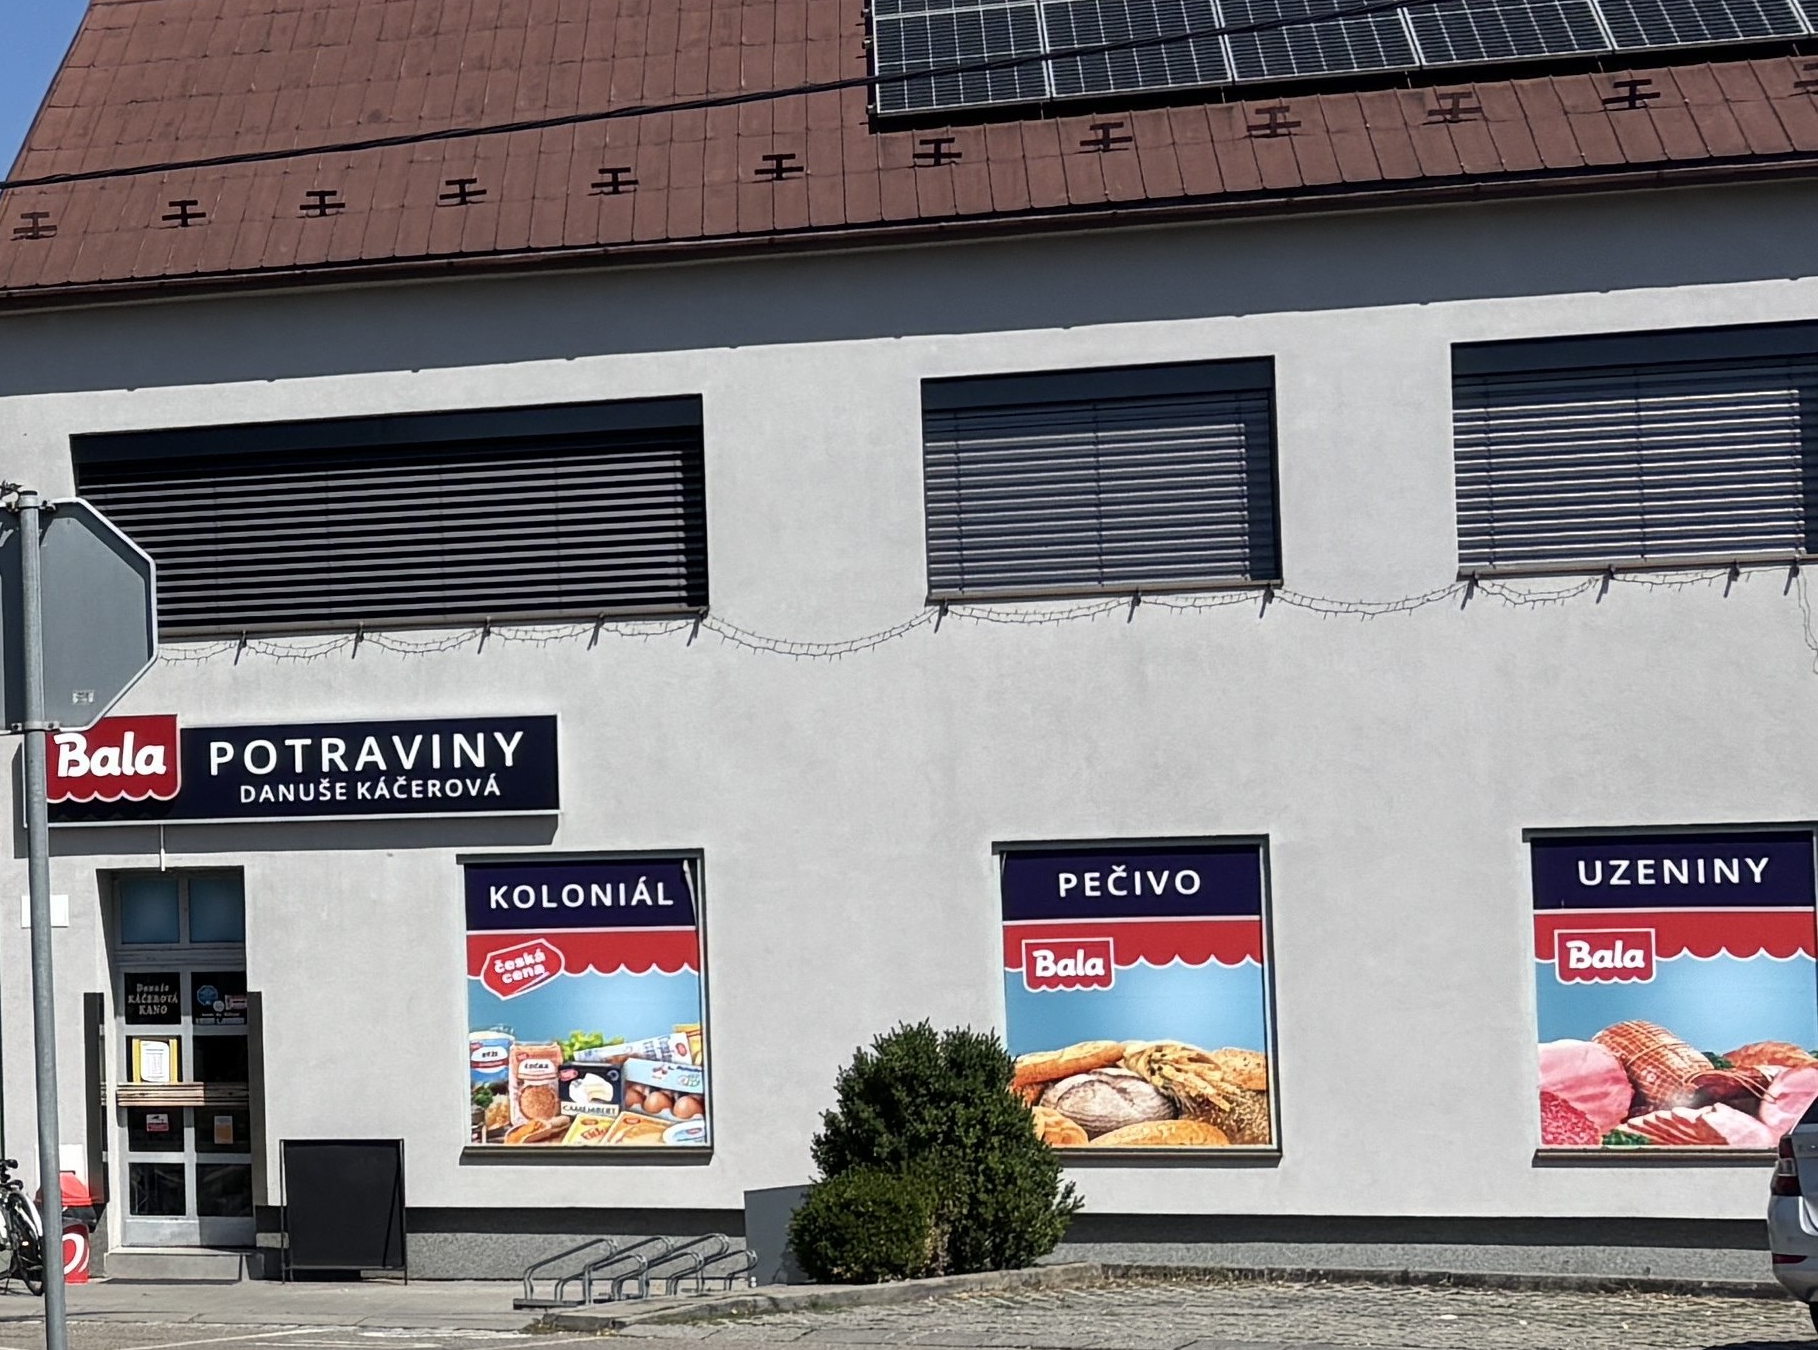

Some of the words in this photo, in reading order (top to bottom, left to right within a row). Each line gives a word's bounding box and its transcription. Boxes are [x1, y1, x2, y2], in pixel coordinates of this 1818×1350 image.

[54, 731, 167, 778] Bala
[209, 730, 525, 776] POTRAVINY
[240, 777, 347, 804] DANUŠE
[357, 772, 501, 800] KÁČEROVÁ
[1058, 864, 1201, 898] PEČIVO
[1577, 857, 1769, 886] UZENINY
[489, 875, 674, 910] KOLONIÁL
[494, 948, 546, 974] česká
[1032, 948, 1106, 978] Bala
[1566, 939, 1646, 970] Bala
[501, 963, 546, 984] cena
